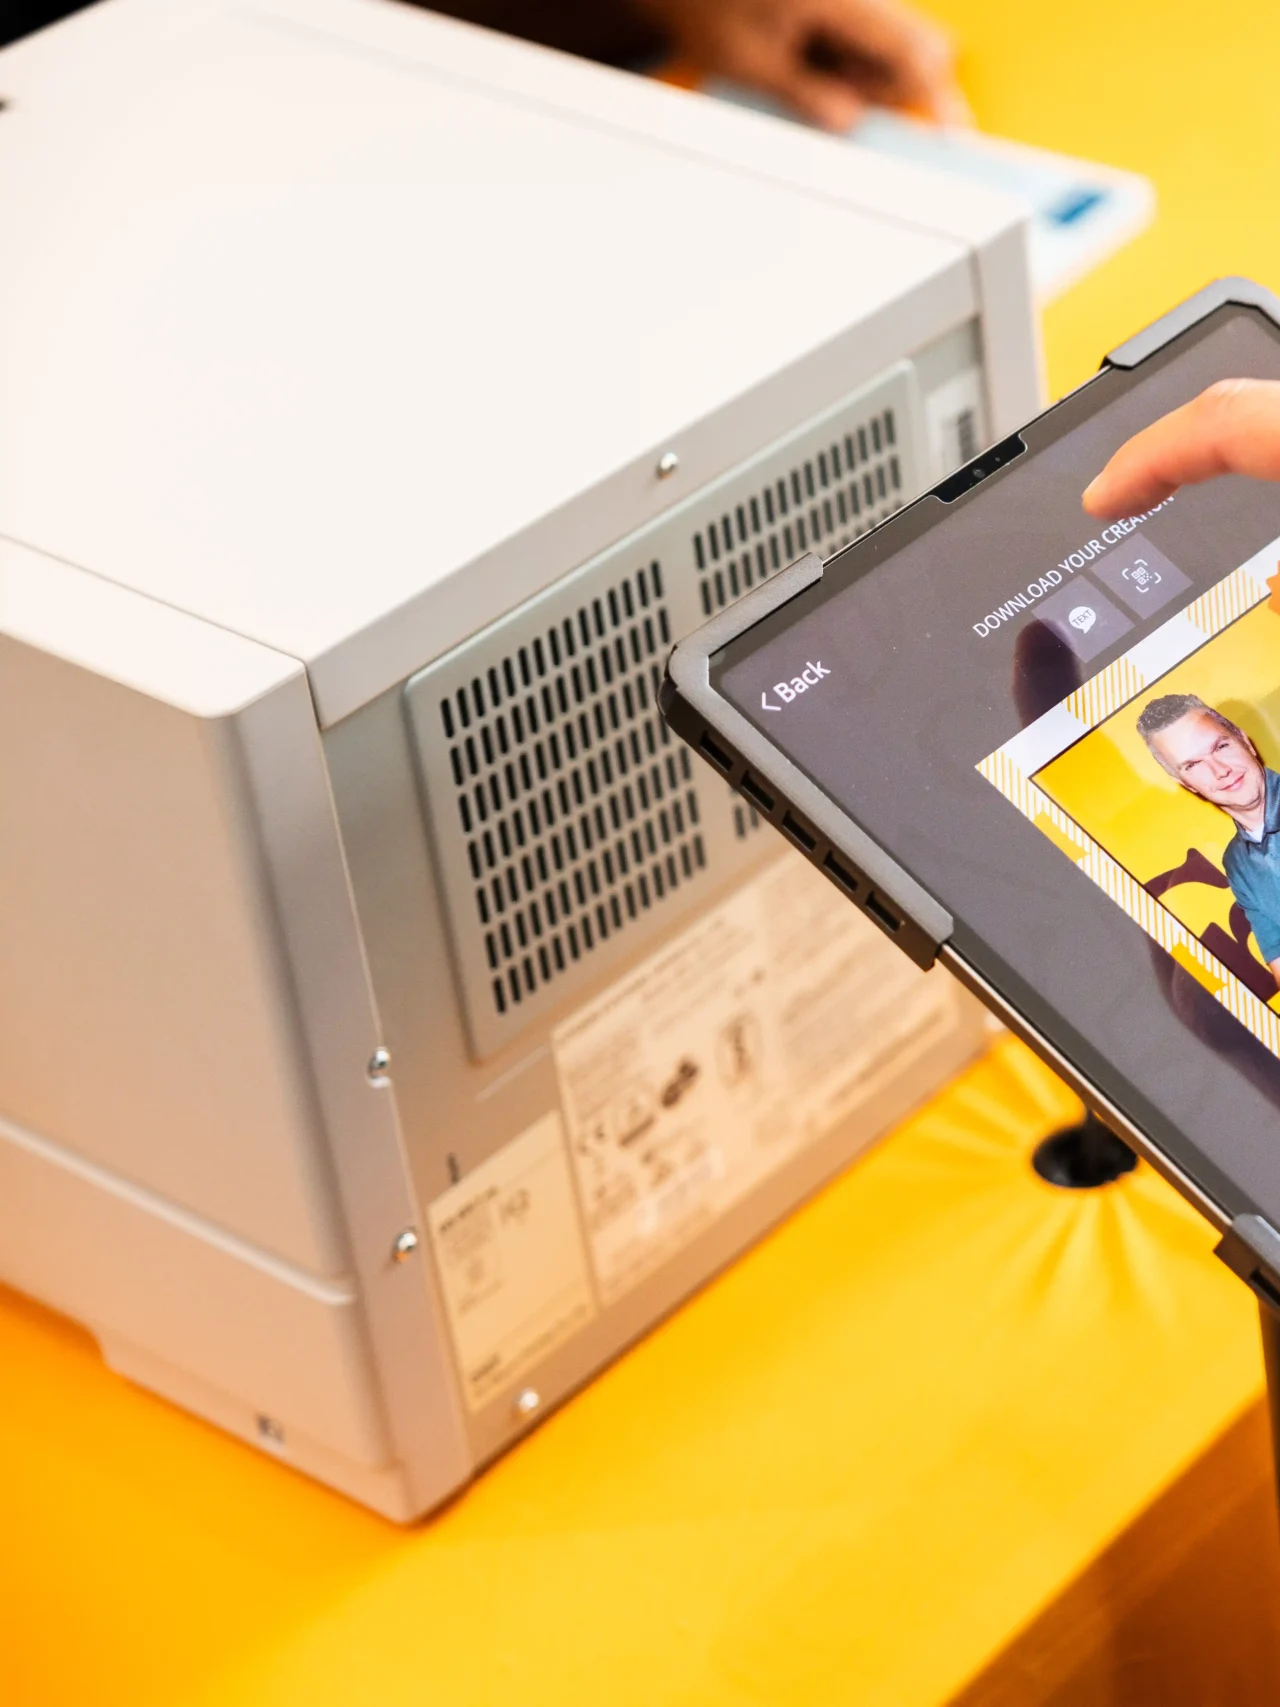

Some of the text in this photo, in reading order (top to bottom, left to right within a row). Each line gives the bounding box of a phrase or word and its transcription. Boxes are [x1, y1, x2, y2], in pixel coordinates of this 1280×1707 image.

[972, 495, 1176, 639] DOWNLOAD YOUR CREA
[1071, 609, 1093, 627] TEXT
[772, 660, 832, 704] Back
